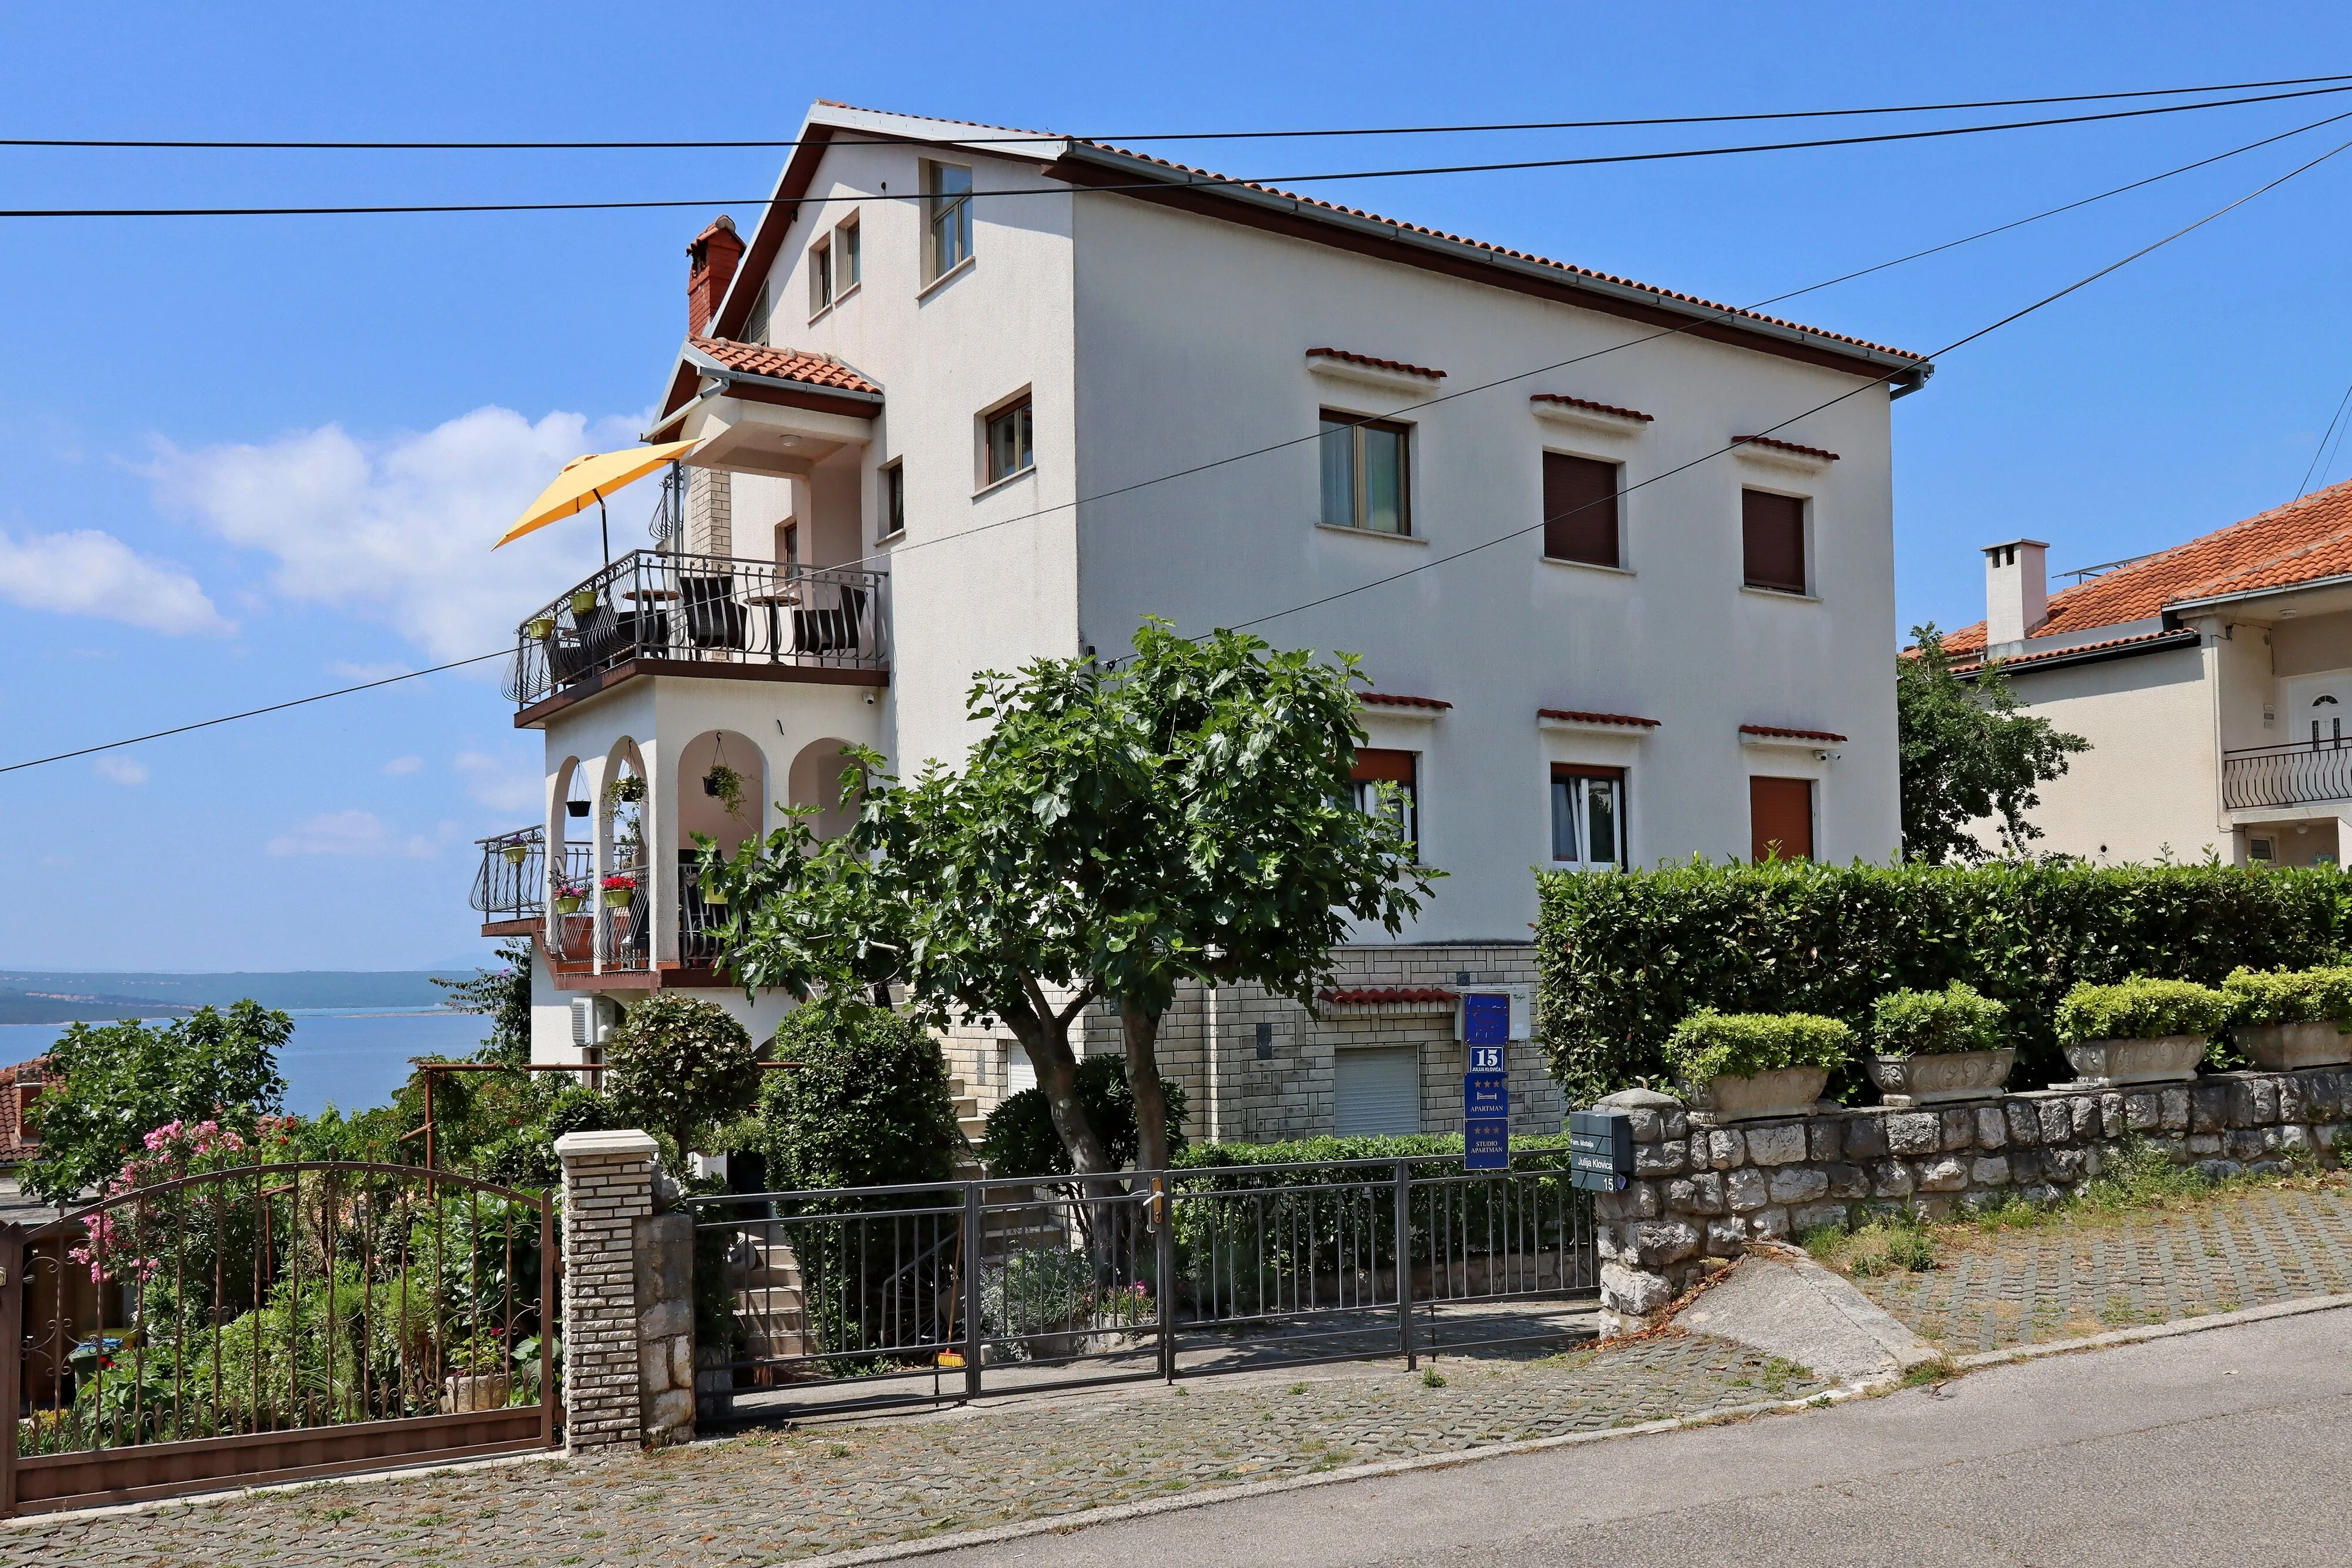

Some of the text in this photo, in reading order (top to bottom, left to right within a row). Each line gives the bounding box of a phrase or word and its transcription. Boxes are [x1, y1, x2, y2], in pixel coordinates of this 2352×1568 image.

[1476, 1049, 1498, 1066] 15
[1578, 1156, 1591, 1169] Julija
[1603, 1178, 1613, 1191] 15
